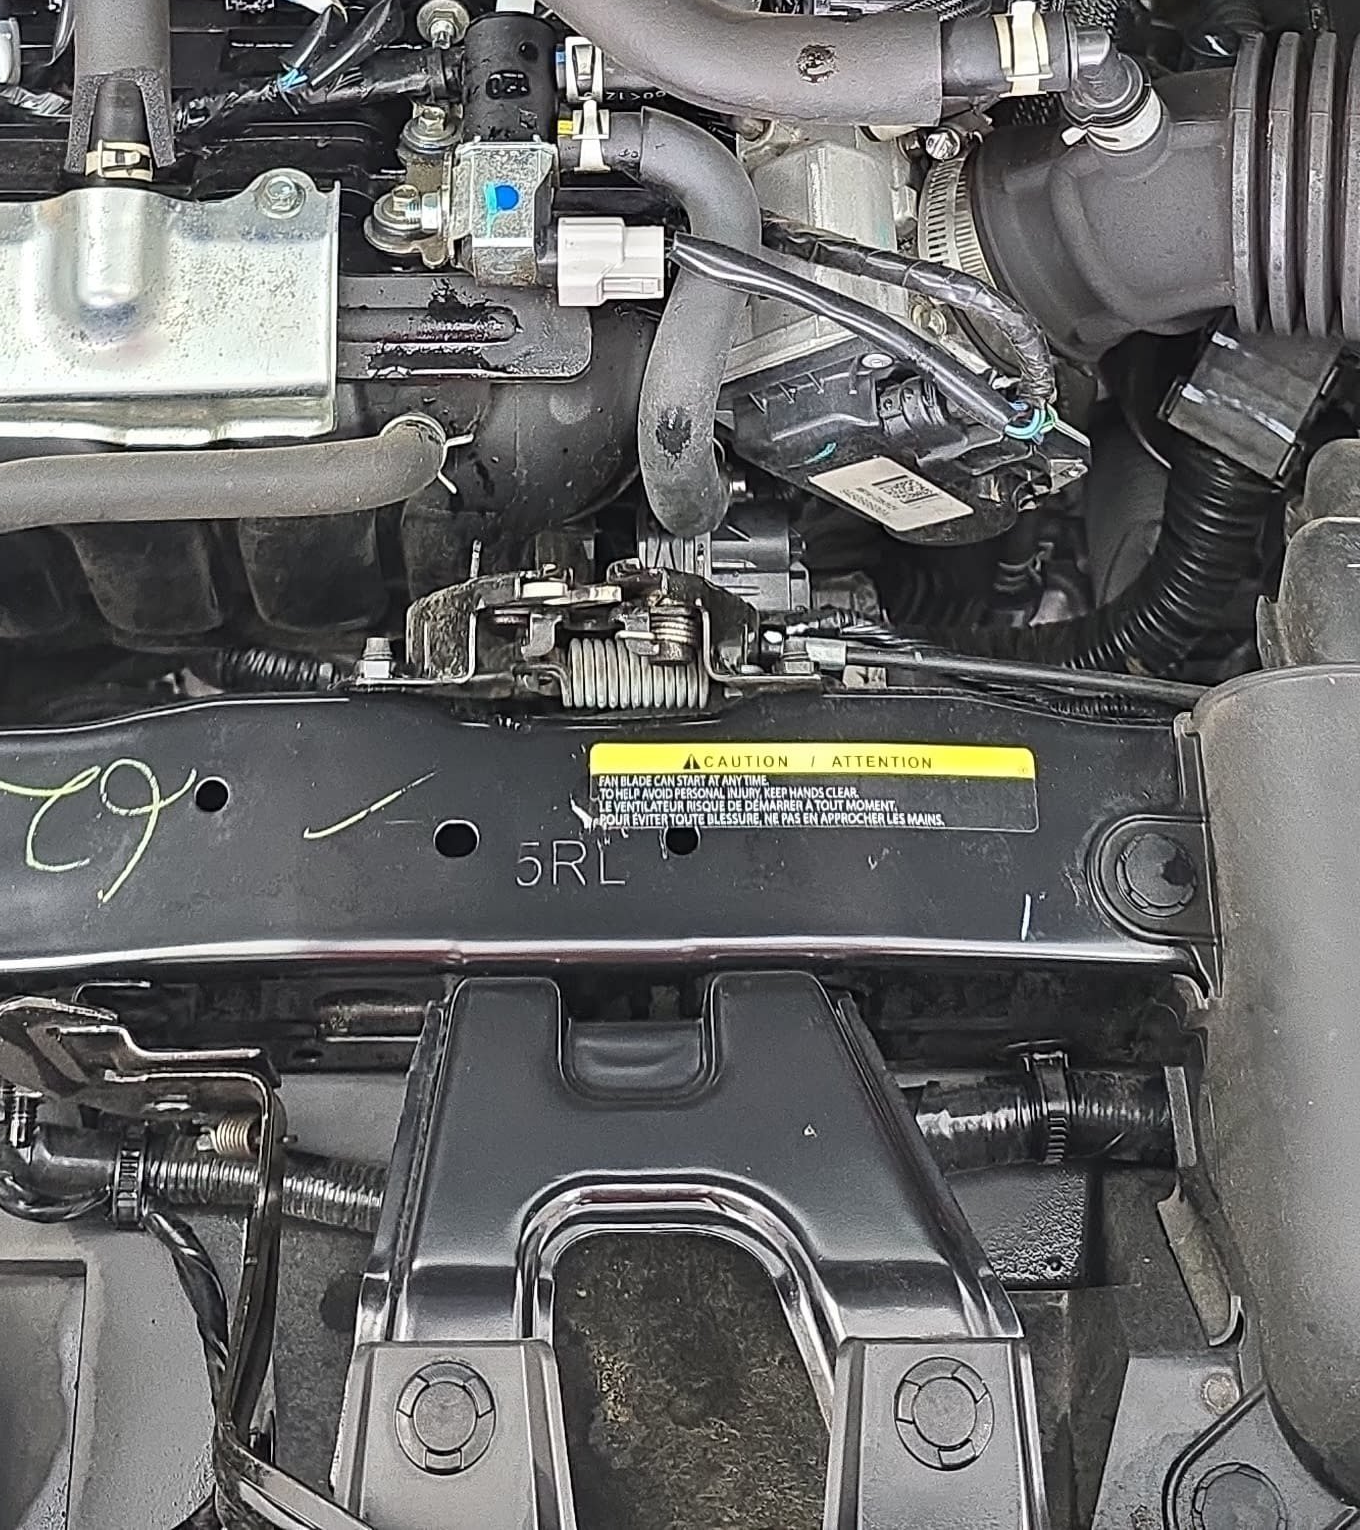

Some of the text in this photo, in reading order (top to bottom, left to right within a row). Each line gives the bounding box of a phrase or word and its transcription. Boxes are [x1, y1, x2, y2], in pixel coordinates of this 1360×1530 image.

[704, 755, 788, 768] CAUTION
[832, 755, 932, 769] ATTENTION
[599, 775, 618, 787] FAN
[620, 775, 652, 787] BLADE
[654, 775, 674, 787] CAN
[676, 775, 706, 787] START
[708, 775, 720, 787] AT
[722, 775, 742, 787] ANY
[599, 787, 859, 800] TO HELP AVOID PERSONAL INJURY, KEEP HANDS CLEAR.
[599, 800, 613, 812] LE
[614, 800, 684, 812] VENTILATEUR
[686, 800, 726, 812] RISQUE
[728, 800, 741, 812] DE
[815, 800, 844, 812] TOUT
[846, 800, 897, 812] MOMENT.
[600, 811, 945, 826] POUR ÉVITER TOUTE BLESSURE, NE PAS EN APPROCHER LES MAINS.
[515, 841, 626, 888] 5RL
